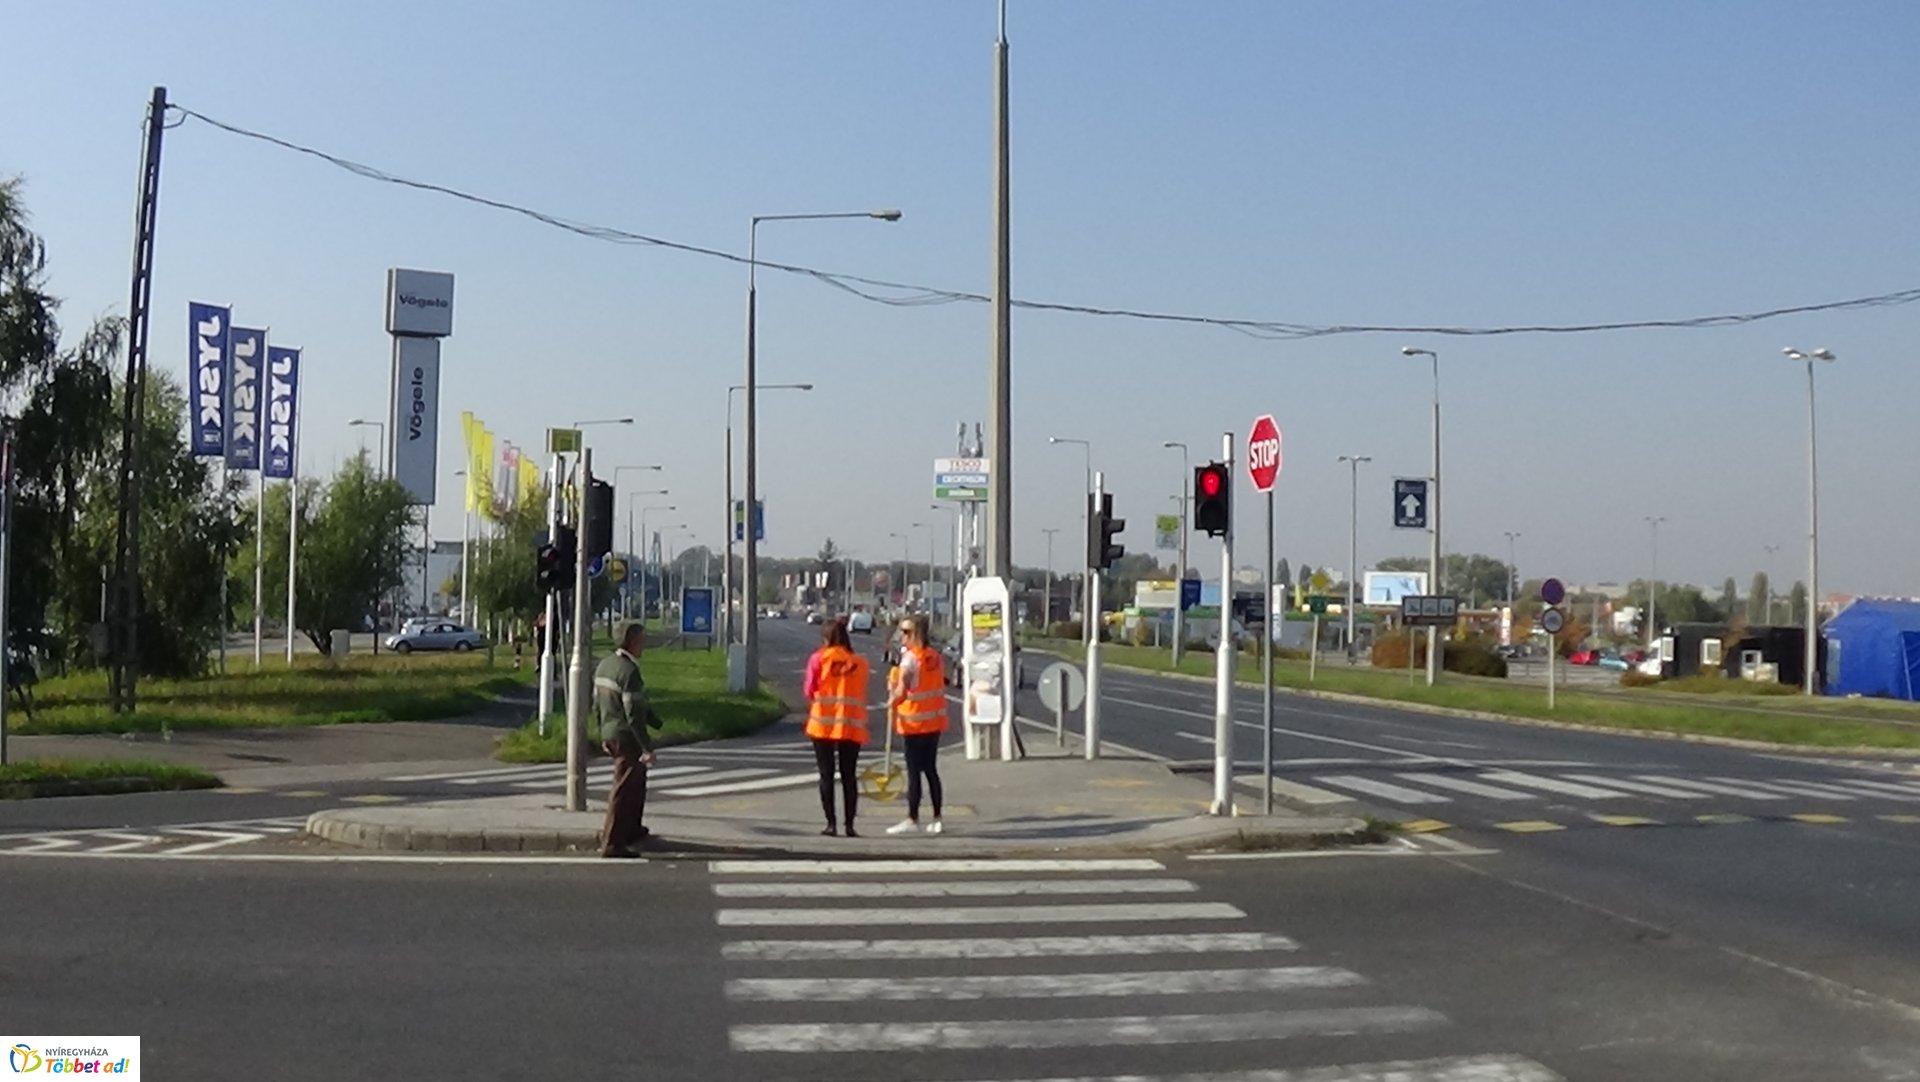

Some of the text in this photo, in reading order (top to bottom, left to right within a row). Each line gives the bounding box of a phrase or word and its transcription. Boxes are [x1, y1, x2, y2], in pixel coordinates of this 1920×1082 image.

[400, 294, 449, 309] Vögele
[409, 366, 425, 441] Vögele
[1250, 438, 1278, 470] STOP
